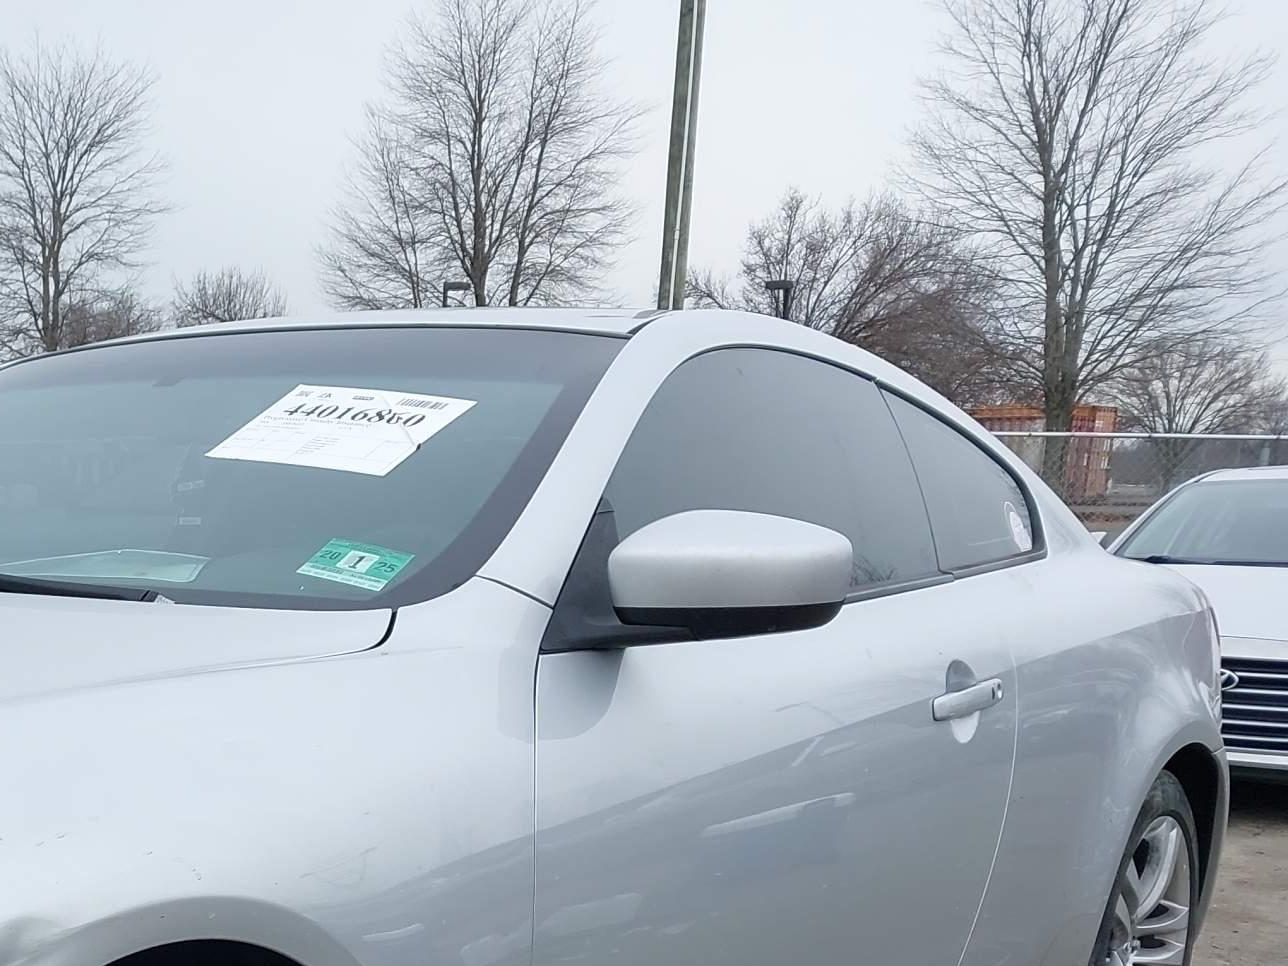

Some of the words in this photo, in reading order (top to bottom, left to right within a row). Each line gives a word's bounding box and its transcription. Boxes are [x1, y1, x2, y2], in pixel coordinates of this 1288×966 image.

[320, 550, 341, 560] 20
[348, 556, 366, 569] 1
[373, 562, 396, 573] 25
